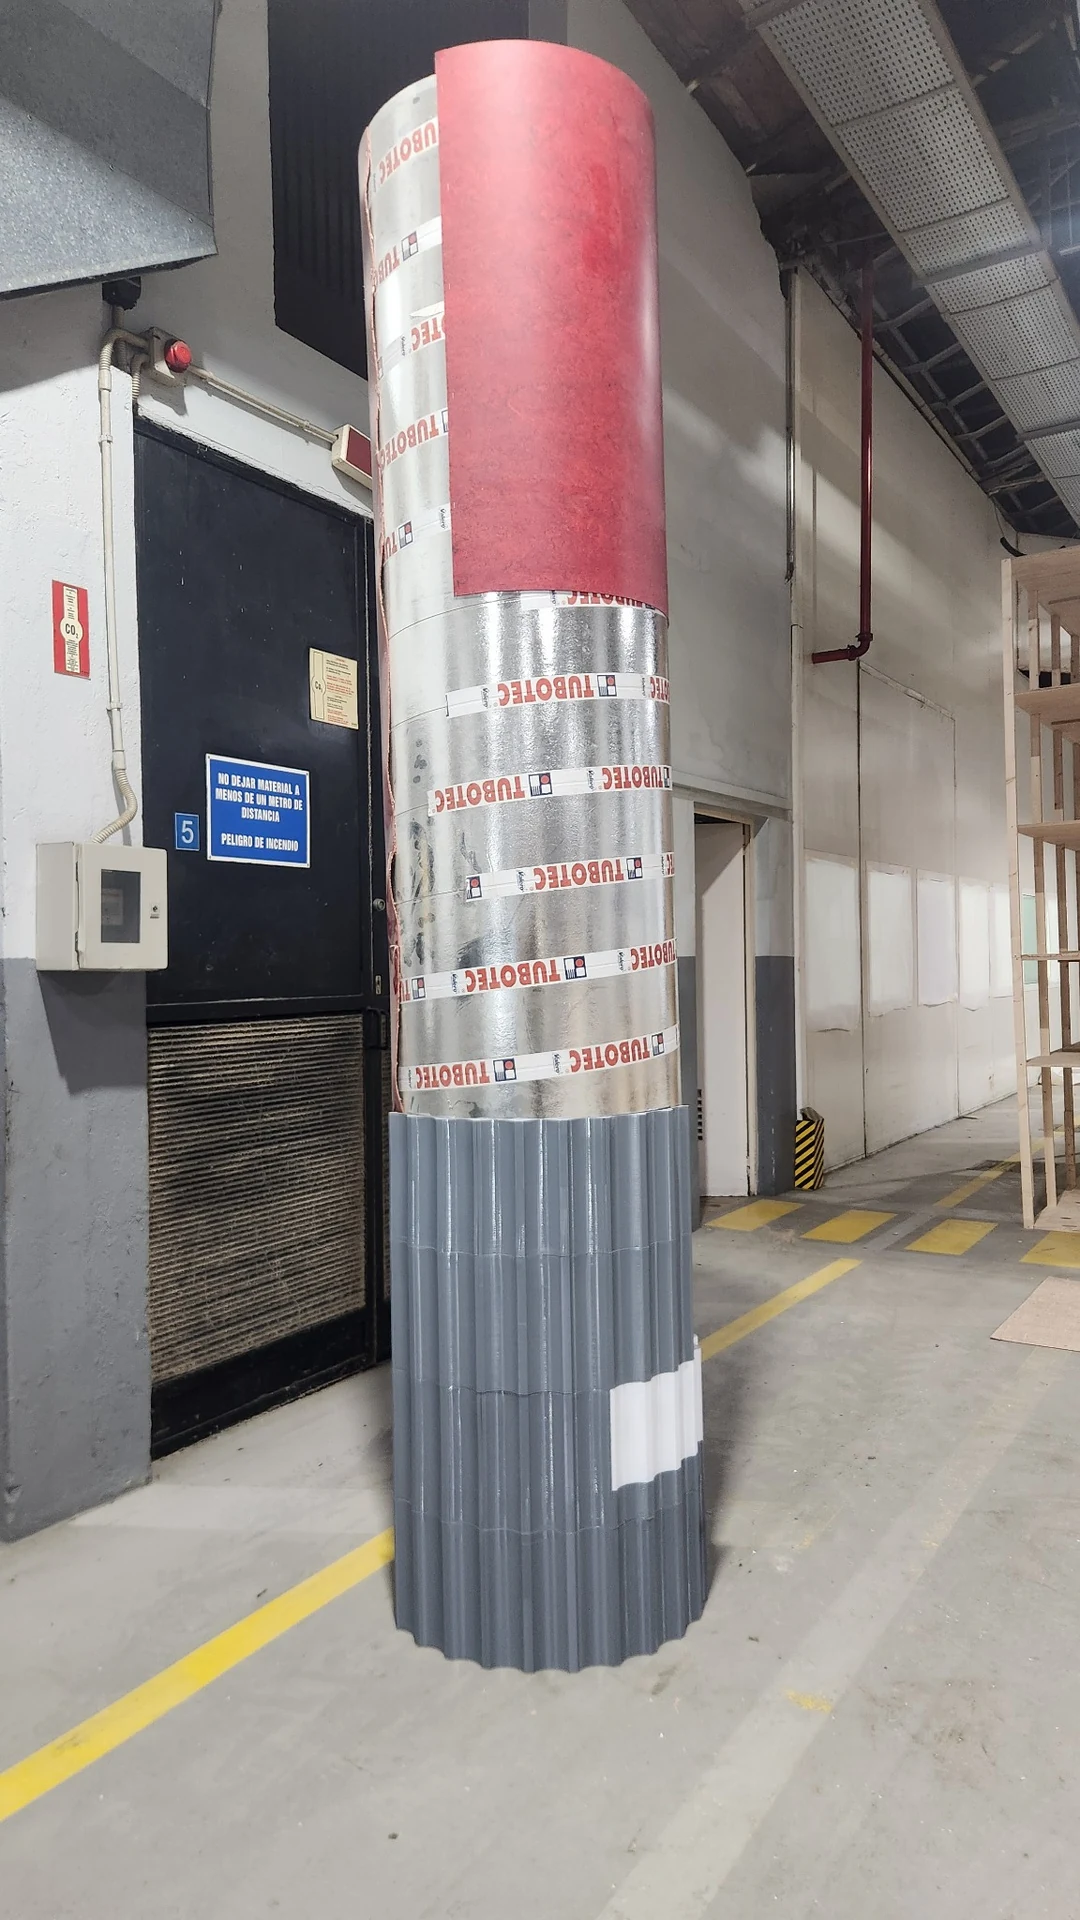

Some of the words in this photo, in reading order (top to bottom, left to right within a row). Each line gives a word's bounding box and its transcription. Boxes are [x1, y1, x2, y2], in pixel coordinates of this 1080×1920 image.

[379, 121, 437, 184] UBOTEC
[497, 675, 594, 707] TUBOTEC
[218, 772, 229, 785] NO
[231, 774, 256, 789] DEJAR
[257, 779, 292, 795] MATERIAL
[295, 784, 300, 796] A
[602, 766, 664, 790] TUBOTEC
[215, 788, 243, 803] MENOS
[244, 792, 254, 804] DE
[256, 794, 267, 806] UN
[268, 796, 292, 810] METRO
[293, 799, 303, 811] DE
[434, 775, 525, 813] TUBOTEC
[241, 807, 280, 823] DISTANCIA
[181, 820, 194, 844] 5
[221, 833, 253, 848] PELIGRO
[254, 836, 264, 849] DE
[266, 837, 299, 852] INCENDIO
[533, 858, 625, 890] TUBOTEC
[465, 959, 561, 993] TUBOTEC
[569, 1037, 650, 1073] TUBOTEC
[415, 1060, 490, 1089] TUBOTEC
